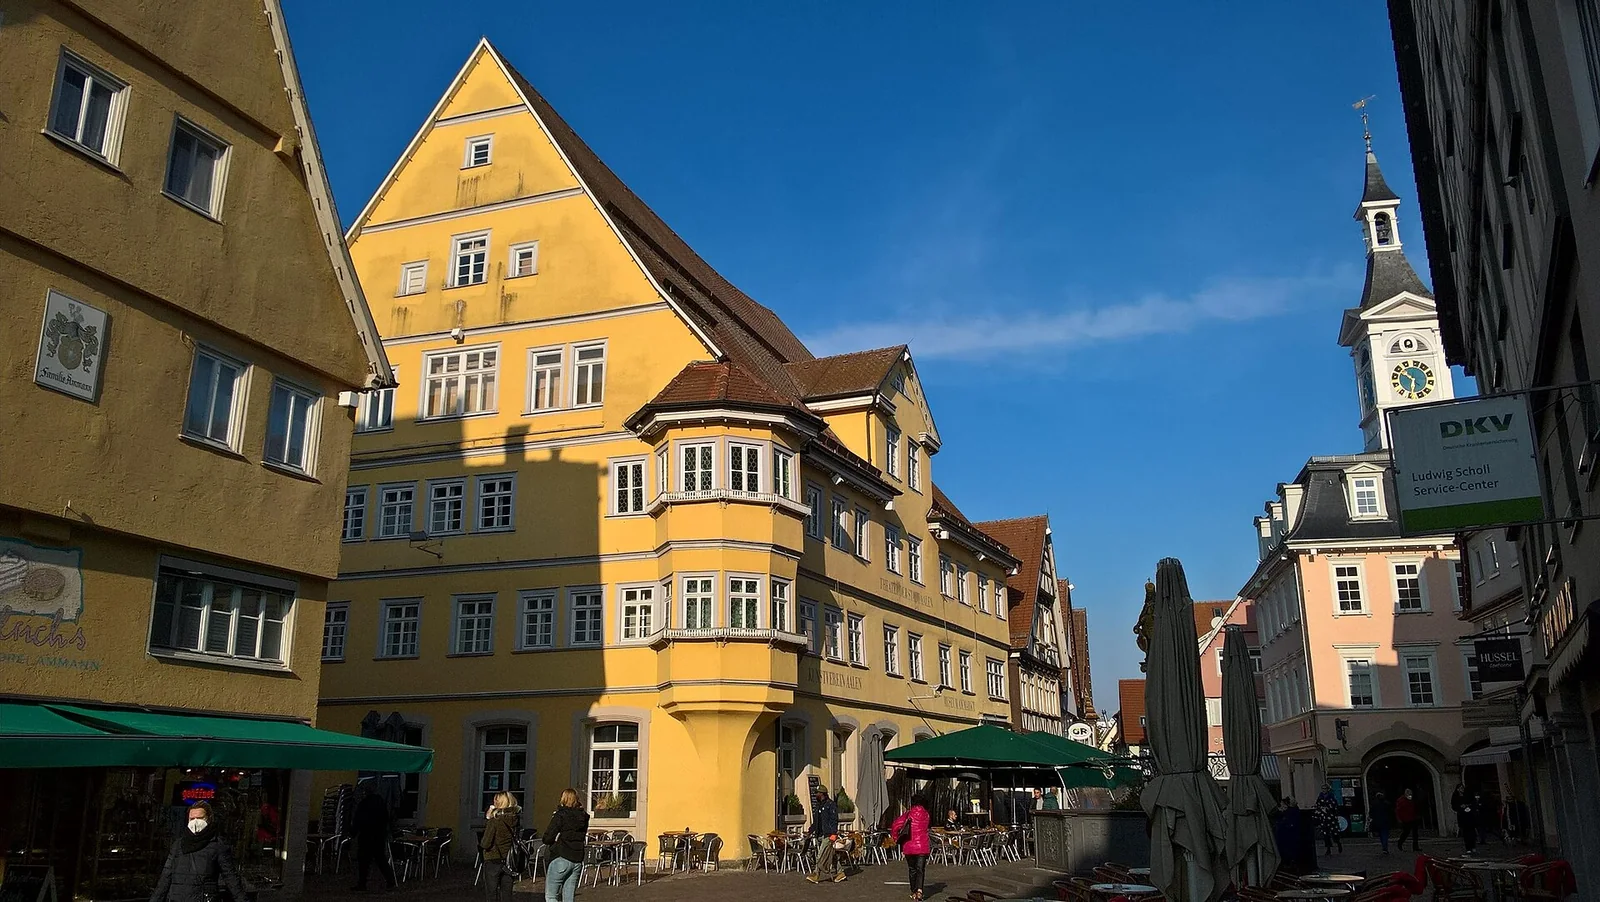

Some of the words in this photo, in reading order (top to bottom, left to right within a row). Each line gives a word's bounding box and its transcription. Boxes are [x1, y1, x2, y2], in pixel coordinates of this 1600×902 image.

[1439, 413, 1514, 438] DKV
[1442, 443, 1466, 451] Deutsche
[1466, 438, 1518, 448] Krankenversicherung
[1412, 467, 1453, 482] Ludwig
[1456, 464, 1490, 477] Scholl
[1414, 479, 1499, 497] Service-Center
[1480, 651, 1519, 663] HUSSEL
